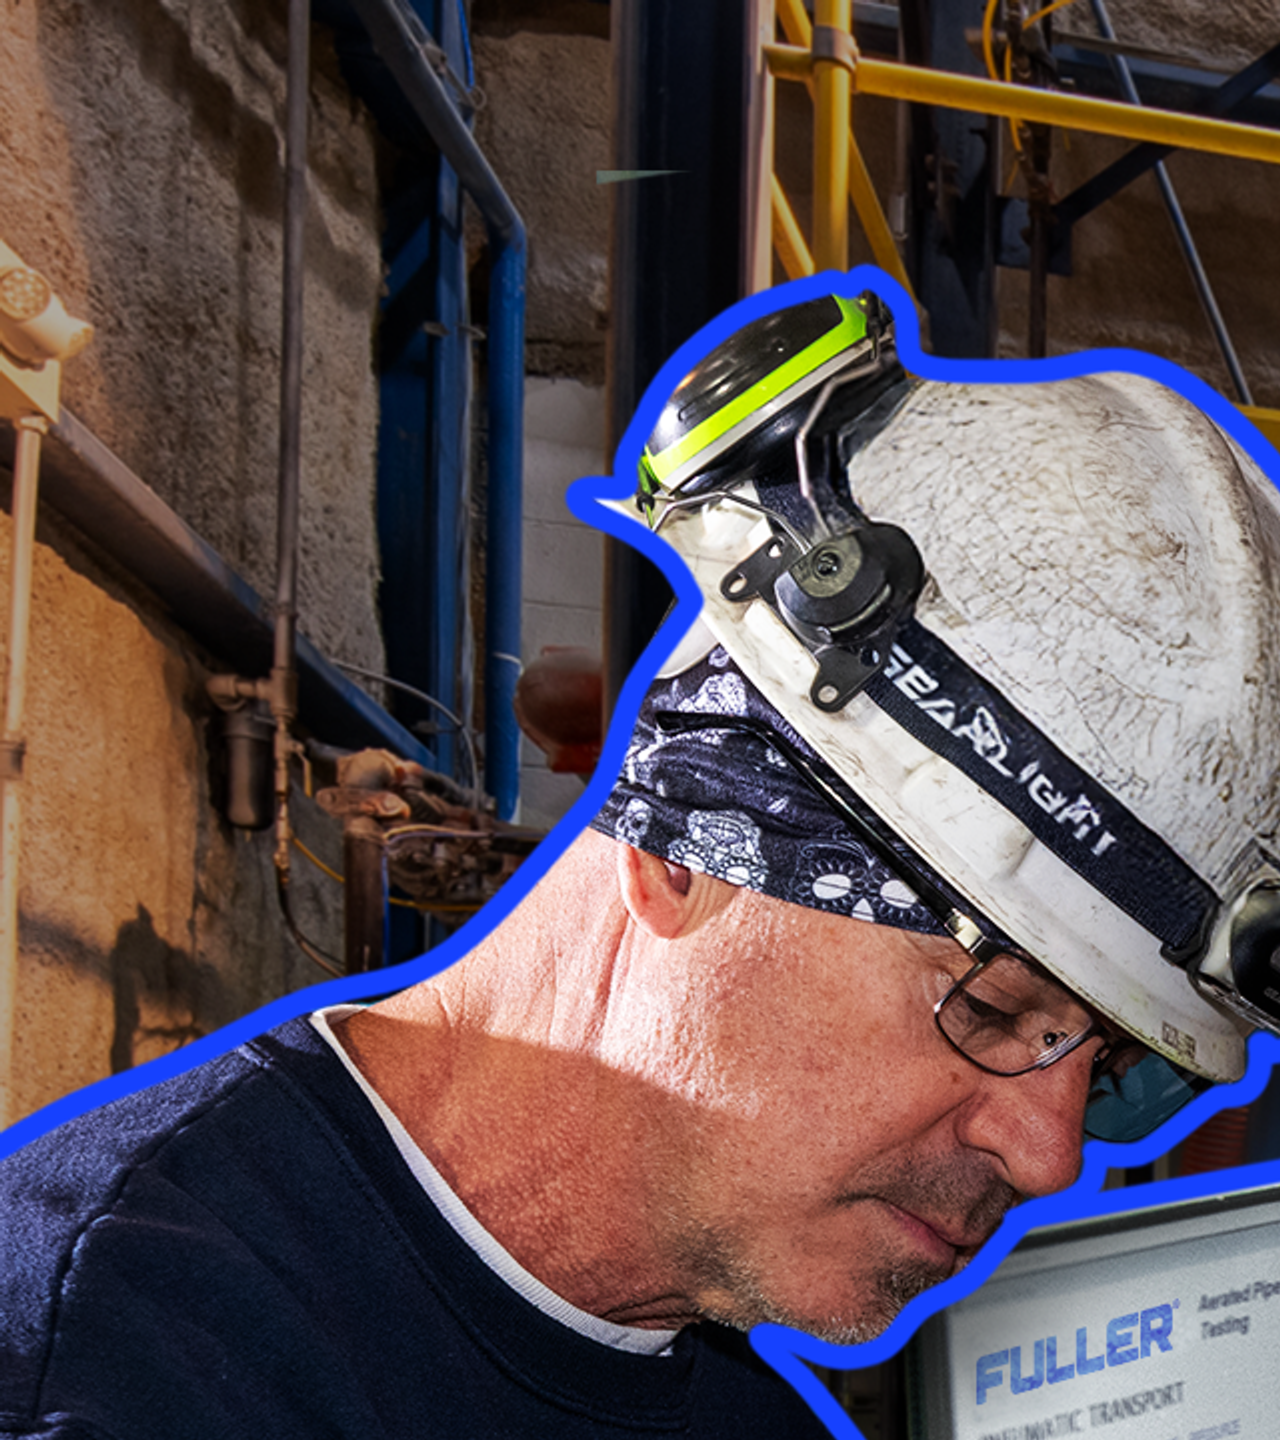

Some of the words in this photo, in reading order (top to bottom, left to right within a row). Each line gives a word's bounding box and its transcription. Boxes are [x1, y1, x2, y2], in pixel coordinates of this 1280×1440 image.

[1199, 1287, 1250, 1312] Aerated
[1201, 1315, 1250, 1339] Testing
[976, 1303, 1173, 1405] FULLER
[1088, 1380, 1185, 1427] TRANSPORT
